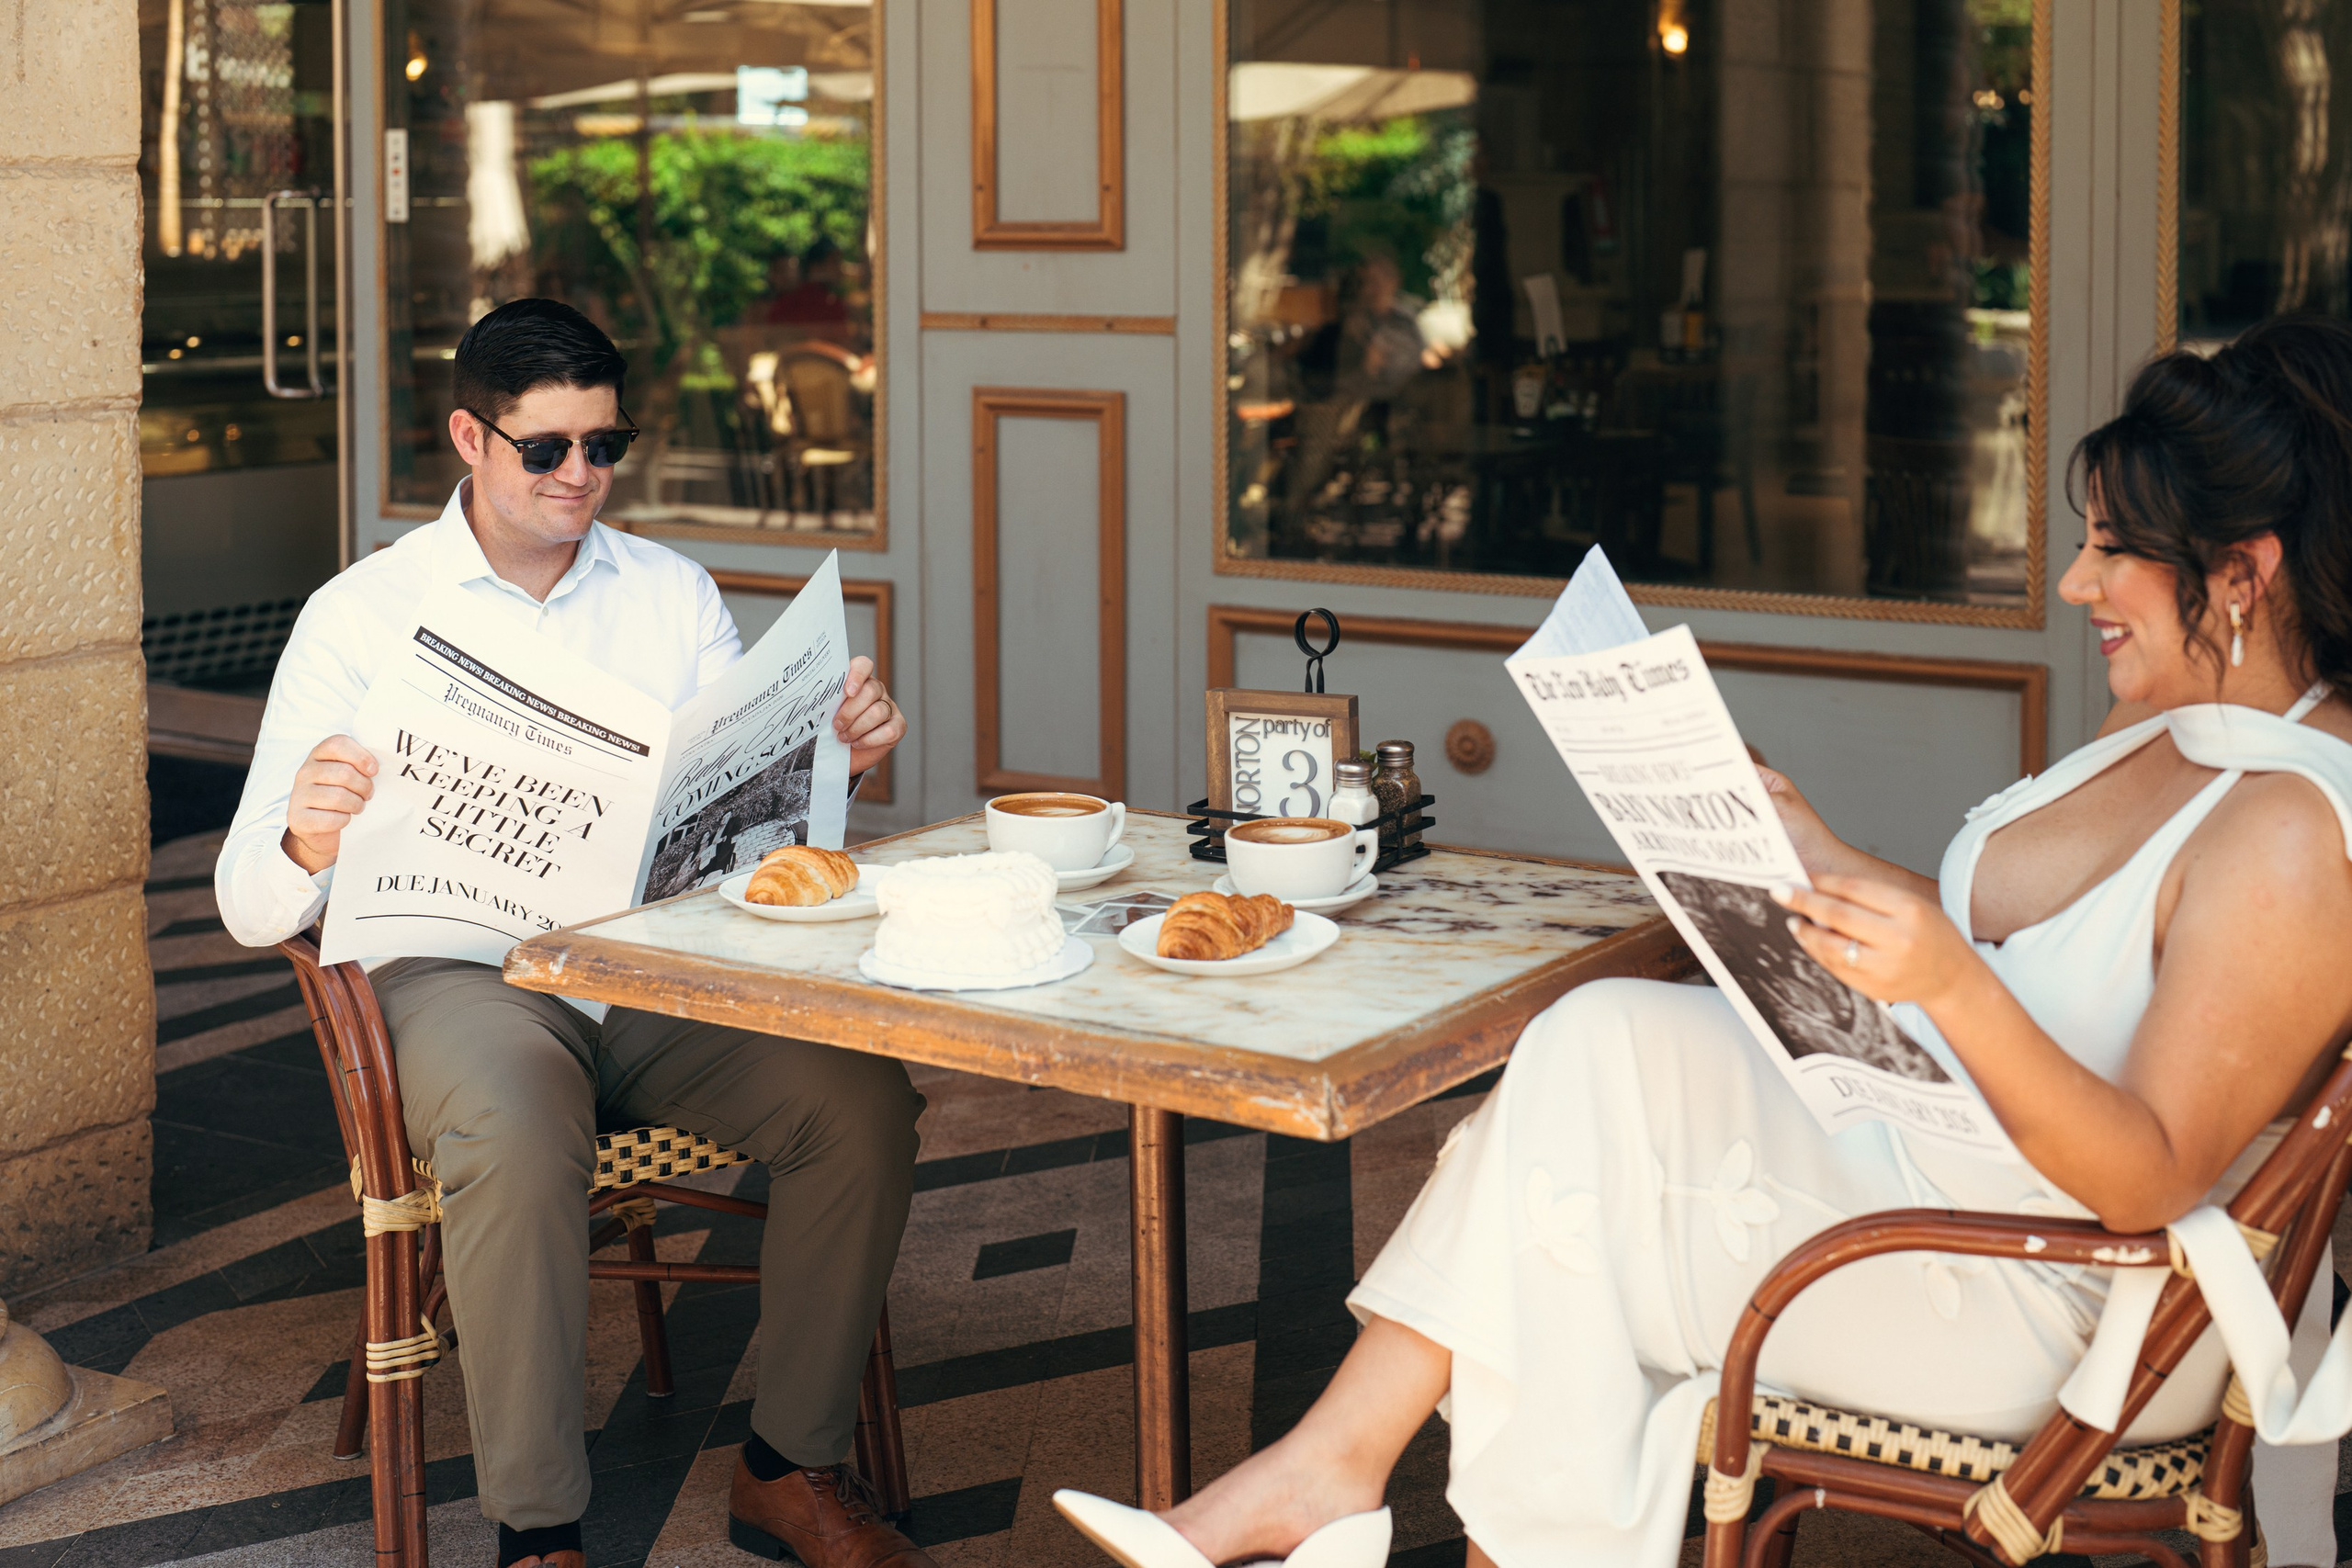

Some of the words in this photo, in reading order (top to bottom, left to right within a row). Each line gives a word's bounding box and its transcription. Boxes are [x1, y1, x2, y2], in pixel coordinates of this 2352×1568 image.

[420, 632, 459, 660] BREAKING
[458, 654, 484, 677] NEWS!
[483, 671, 526, 702] BREAKING
[526, 695, 558, 716] NEWS!
[558, 712, 606, 739] BREAKING
[607, 734, 640, 752] NEWS!
[444, 682, 520, 737] Pregnancy
[525, 725, 572, 756] Times
[712, 681, 779, 734] Pregnancy
[782, 647, 812, 683] Times
[656, 739, 742, 818] Baby
[744, 671, 845, 753] Norton
[1263, 718, 1311, 741] party
[1313, 718, 1331, 738] of
[397, 763, 562, 825] KEEPING
[564, 821, 594, 841] A
[511, 773, 615, 818] BEEN
[662, 758, 754, 827] COMING
[756, 711, 825, 766] SOON!
[1279, 750, 1321, 818] 3
[428, 794, 560, 853] LITTLE
[1645, 785, 1761, 830] NORTON
[420, 817, 561, 880] SECRET
[374, 874, 425, 893] DUE
[427, 876, 533, 921] JANUARY
[537, 914, 565, 931] 20
